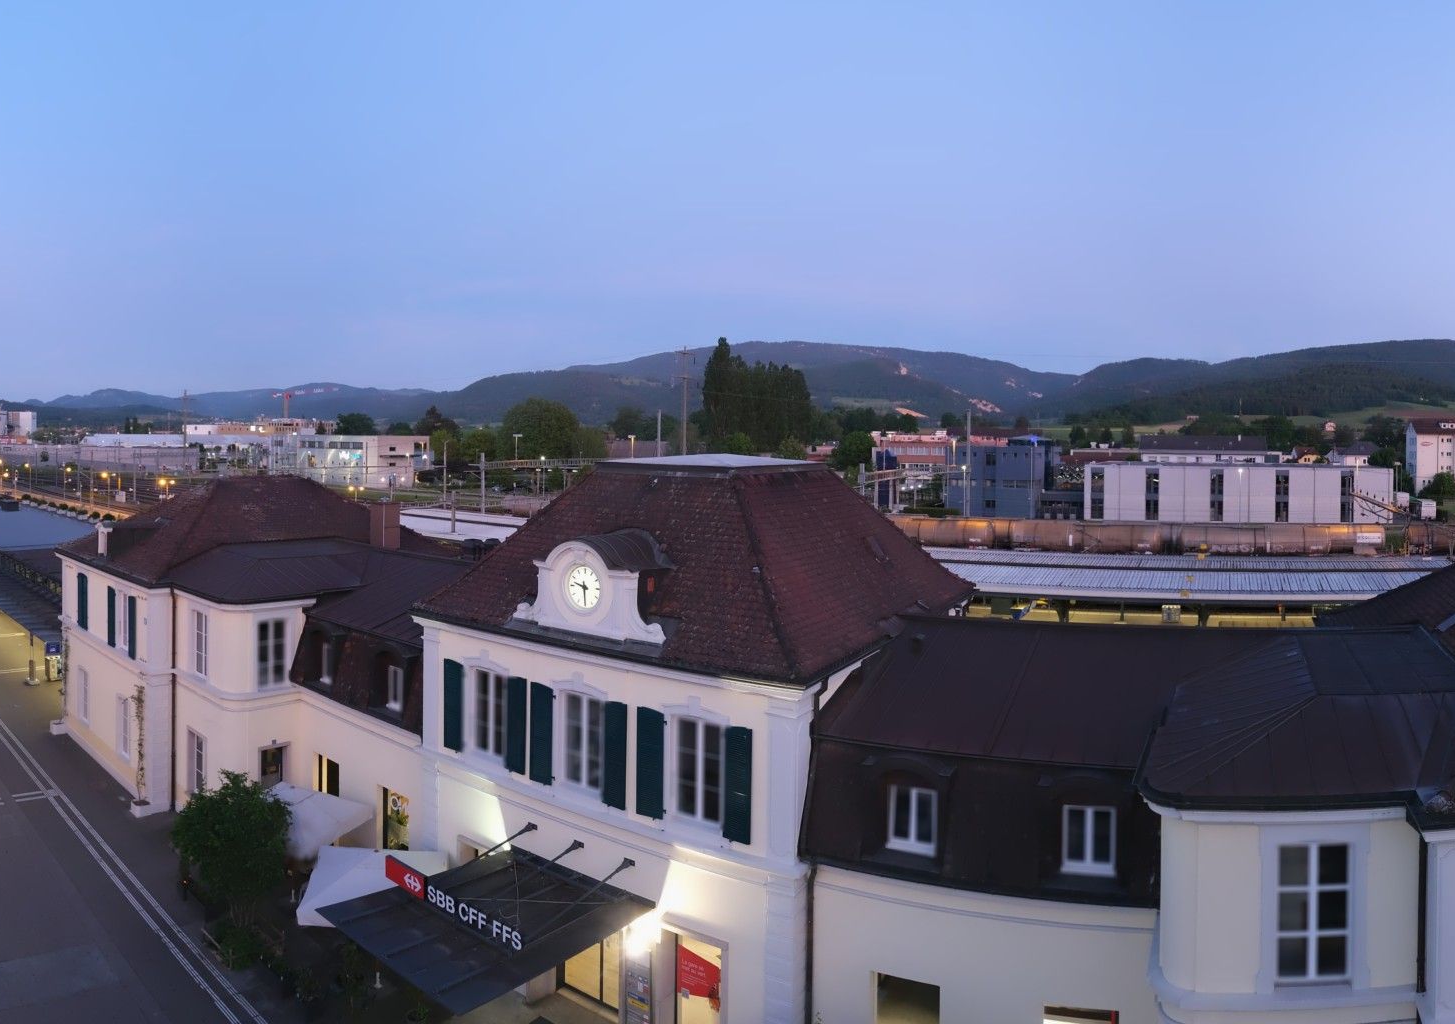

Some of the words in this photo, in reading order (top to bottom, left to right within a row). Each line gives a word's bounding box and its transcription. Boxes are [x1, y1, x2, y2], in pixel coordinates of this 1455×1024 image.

[427, 885, 456, 914] SBB
[458, 903, 487, 929] CFF
[492, 919, 522, 951] FFS
